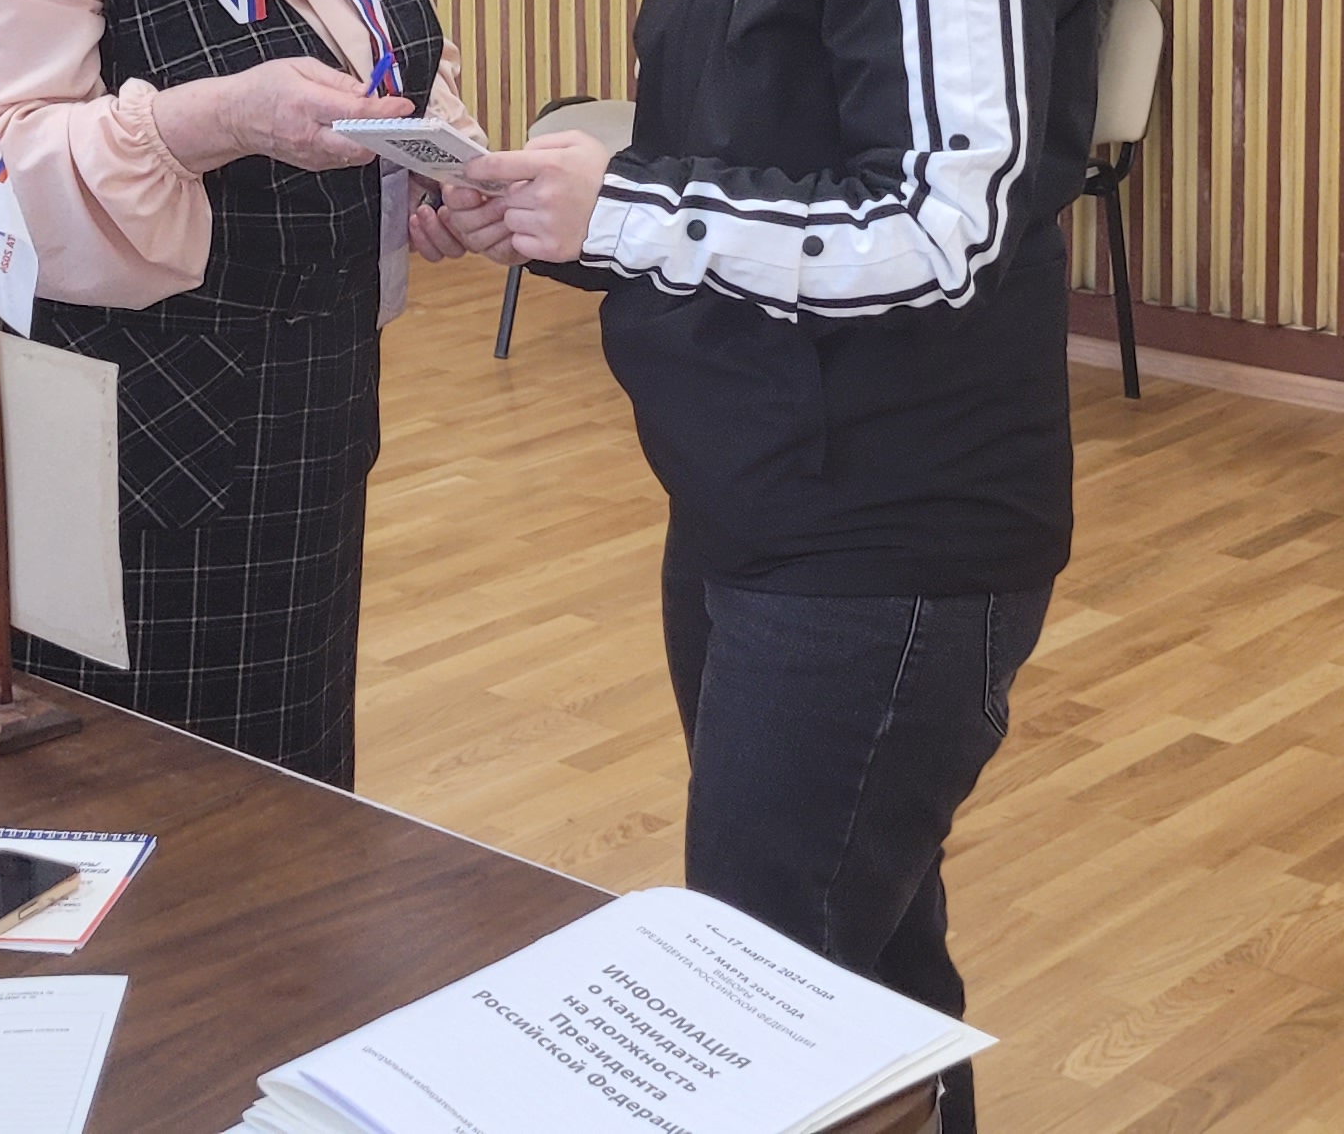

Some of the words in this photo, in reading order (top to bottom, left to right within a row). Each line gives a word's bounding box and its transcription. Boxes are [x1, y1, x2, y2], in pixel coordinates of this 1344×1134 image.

[602, 964, 752, 1069] ИНФОРМАЦИЯ
[636, 926, 694, 969] ПРЕЗИДЕНТА
[693, 966, 757, 1015] РОССИЙСКОЙ
[756, 1012, 816, 1049] ФЕДЕРАЦИИ
[712, 968, 755, 999] ВЫБОРЫ
[714, 955, 749, 983] МАРТА
[749, 981, 776, 1002] 2024
[776, 999, 805, 1020] ГОДА
[740, 946, 777, 970] марта
[777, 966, 807, 985] 2024
[806, 983, 835, 1001] года
[472, 990, 588, 1074] Российской
[549, 1012, 668, 1101] Президента
[563, 995, 590, 1016] на
[586, 1015, 697, 1093] должность
[587, 983, 603, 995] о
[603, 995, 722, 1079] кандидатах
